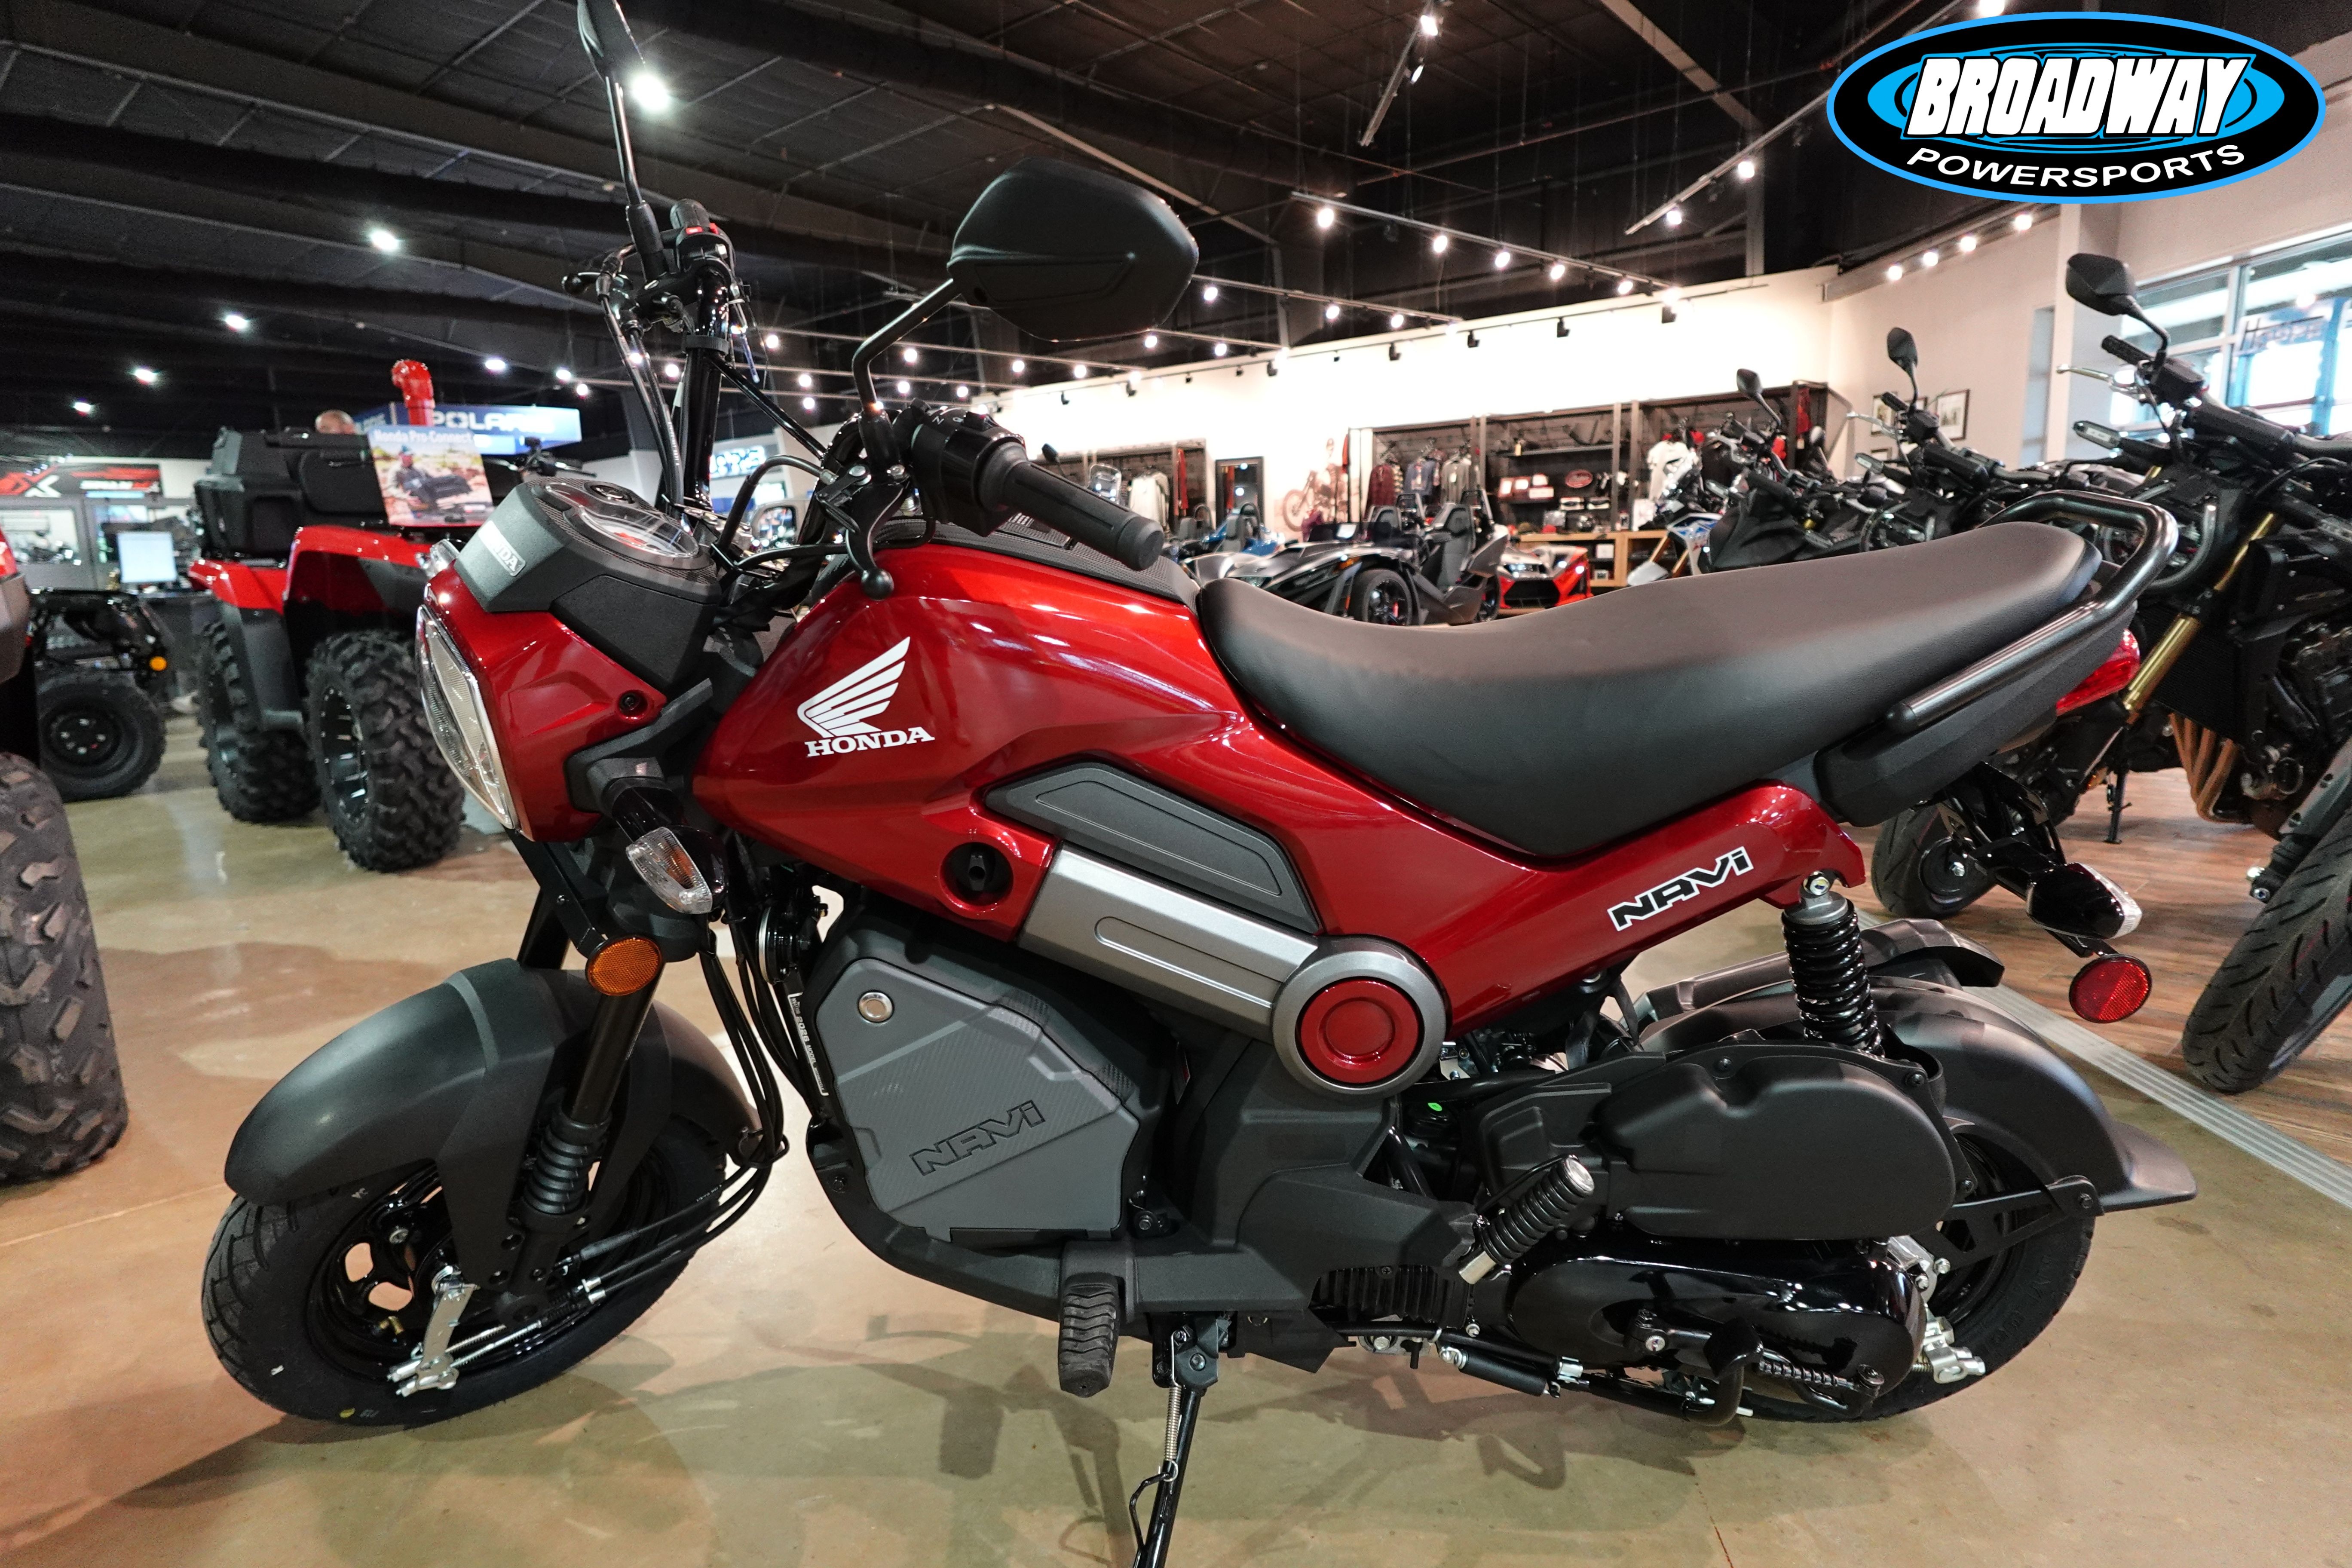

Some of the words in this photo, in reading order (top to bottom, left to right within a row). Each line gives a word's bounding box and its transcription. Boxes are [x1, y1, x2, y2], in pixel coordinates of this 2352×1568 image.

[433, 410, 556, 433] POLAR
[805, 726, 935, 757] HONDA
[796, 1016, 810, 1042] 2026
[806, 1045, 817, 1065] MODEL
